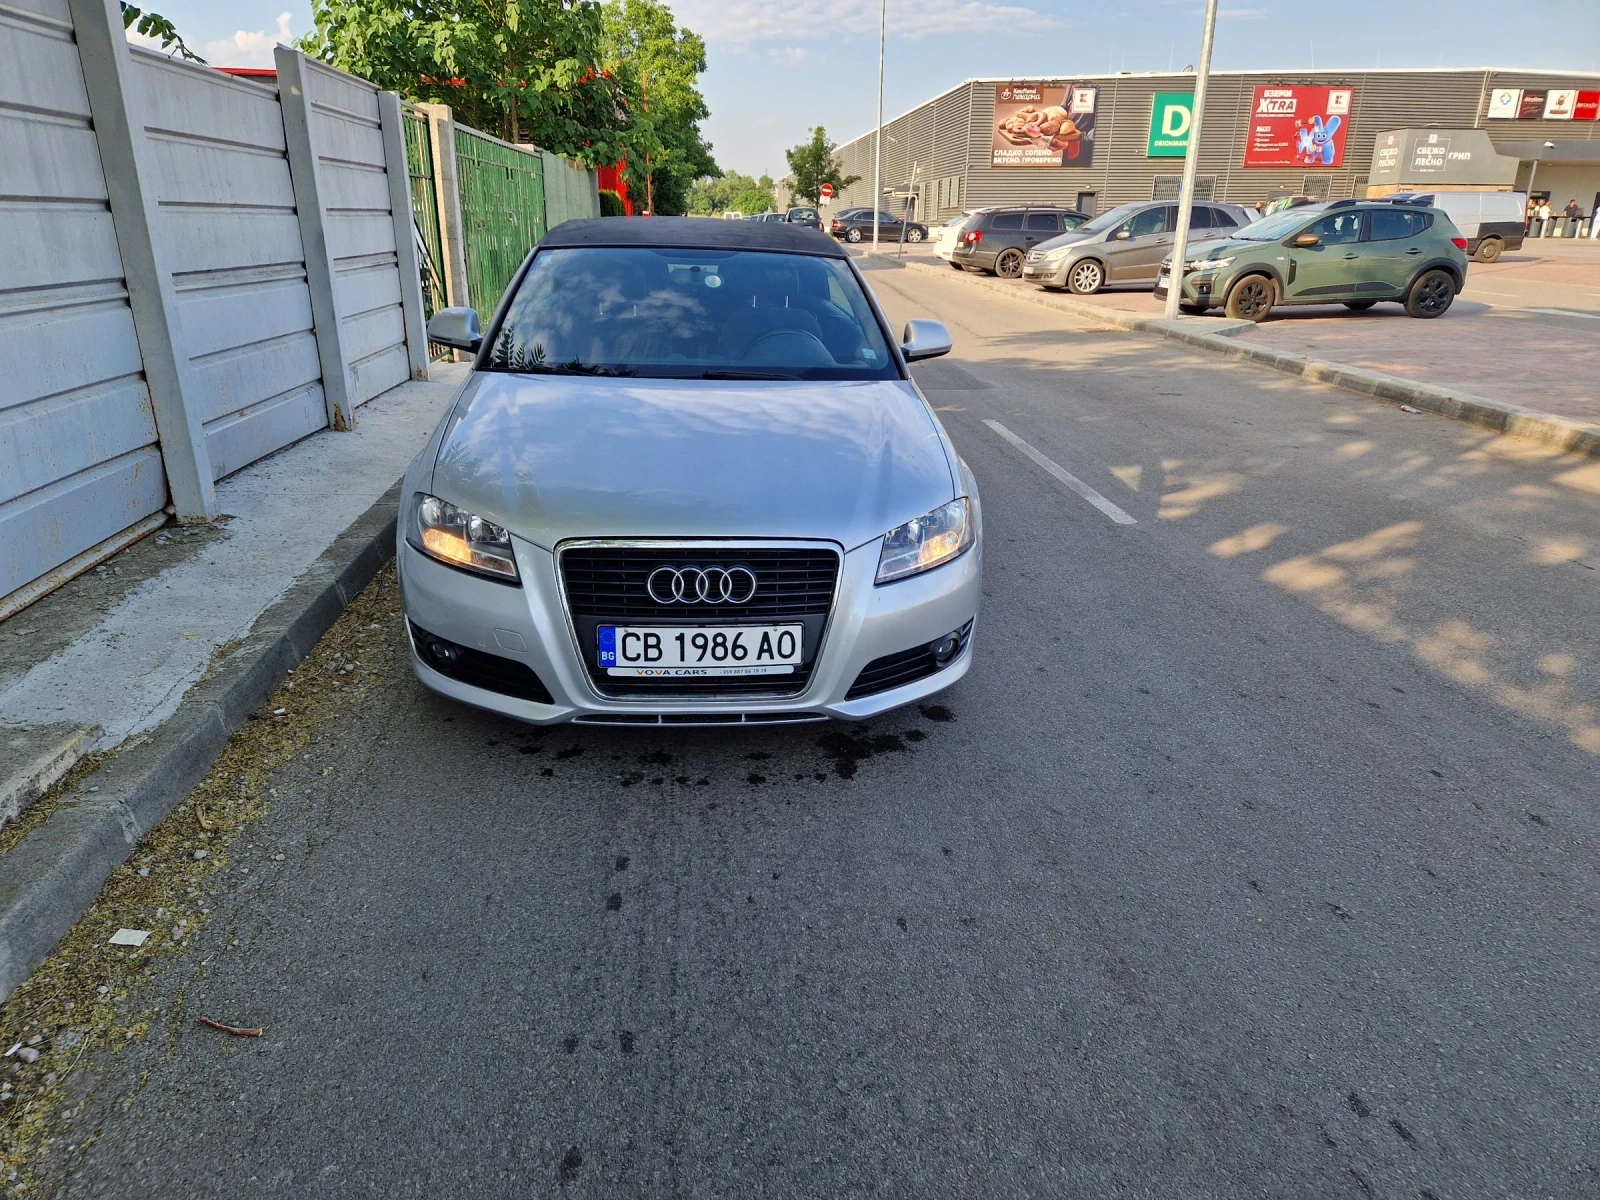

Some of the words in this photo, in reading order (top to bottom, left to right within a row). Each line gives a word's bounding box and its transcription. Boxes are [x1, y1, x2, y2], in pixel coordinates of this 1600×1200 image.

[1256, 98, 1297, 113] XTRA
[1162, 105, 1191, 137] D
[994, 149, 1024, 157] СЛАДКО.
[1417, 146, 1445, 155] СВЕЖО
[1448, 152, 1471, 160] ГРИЛ
[1415, 158, 1443, 166] ЛЕСНО
[601, 651, 615, 661] BG
[621, 632, 663, 663] CB
[675, 631, 748, 662] 1986
